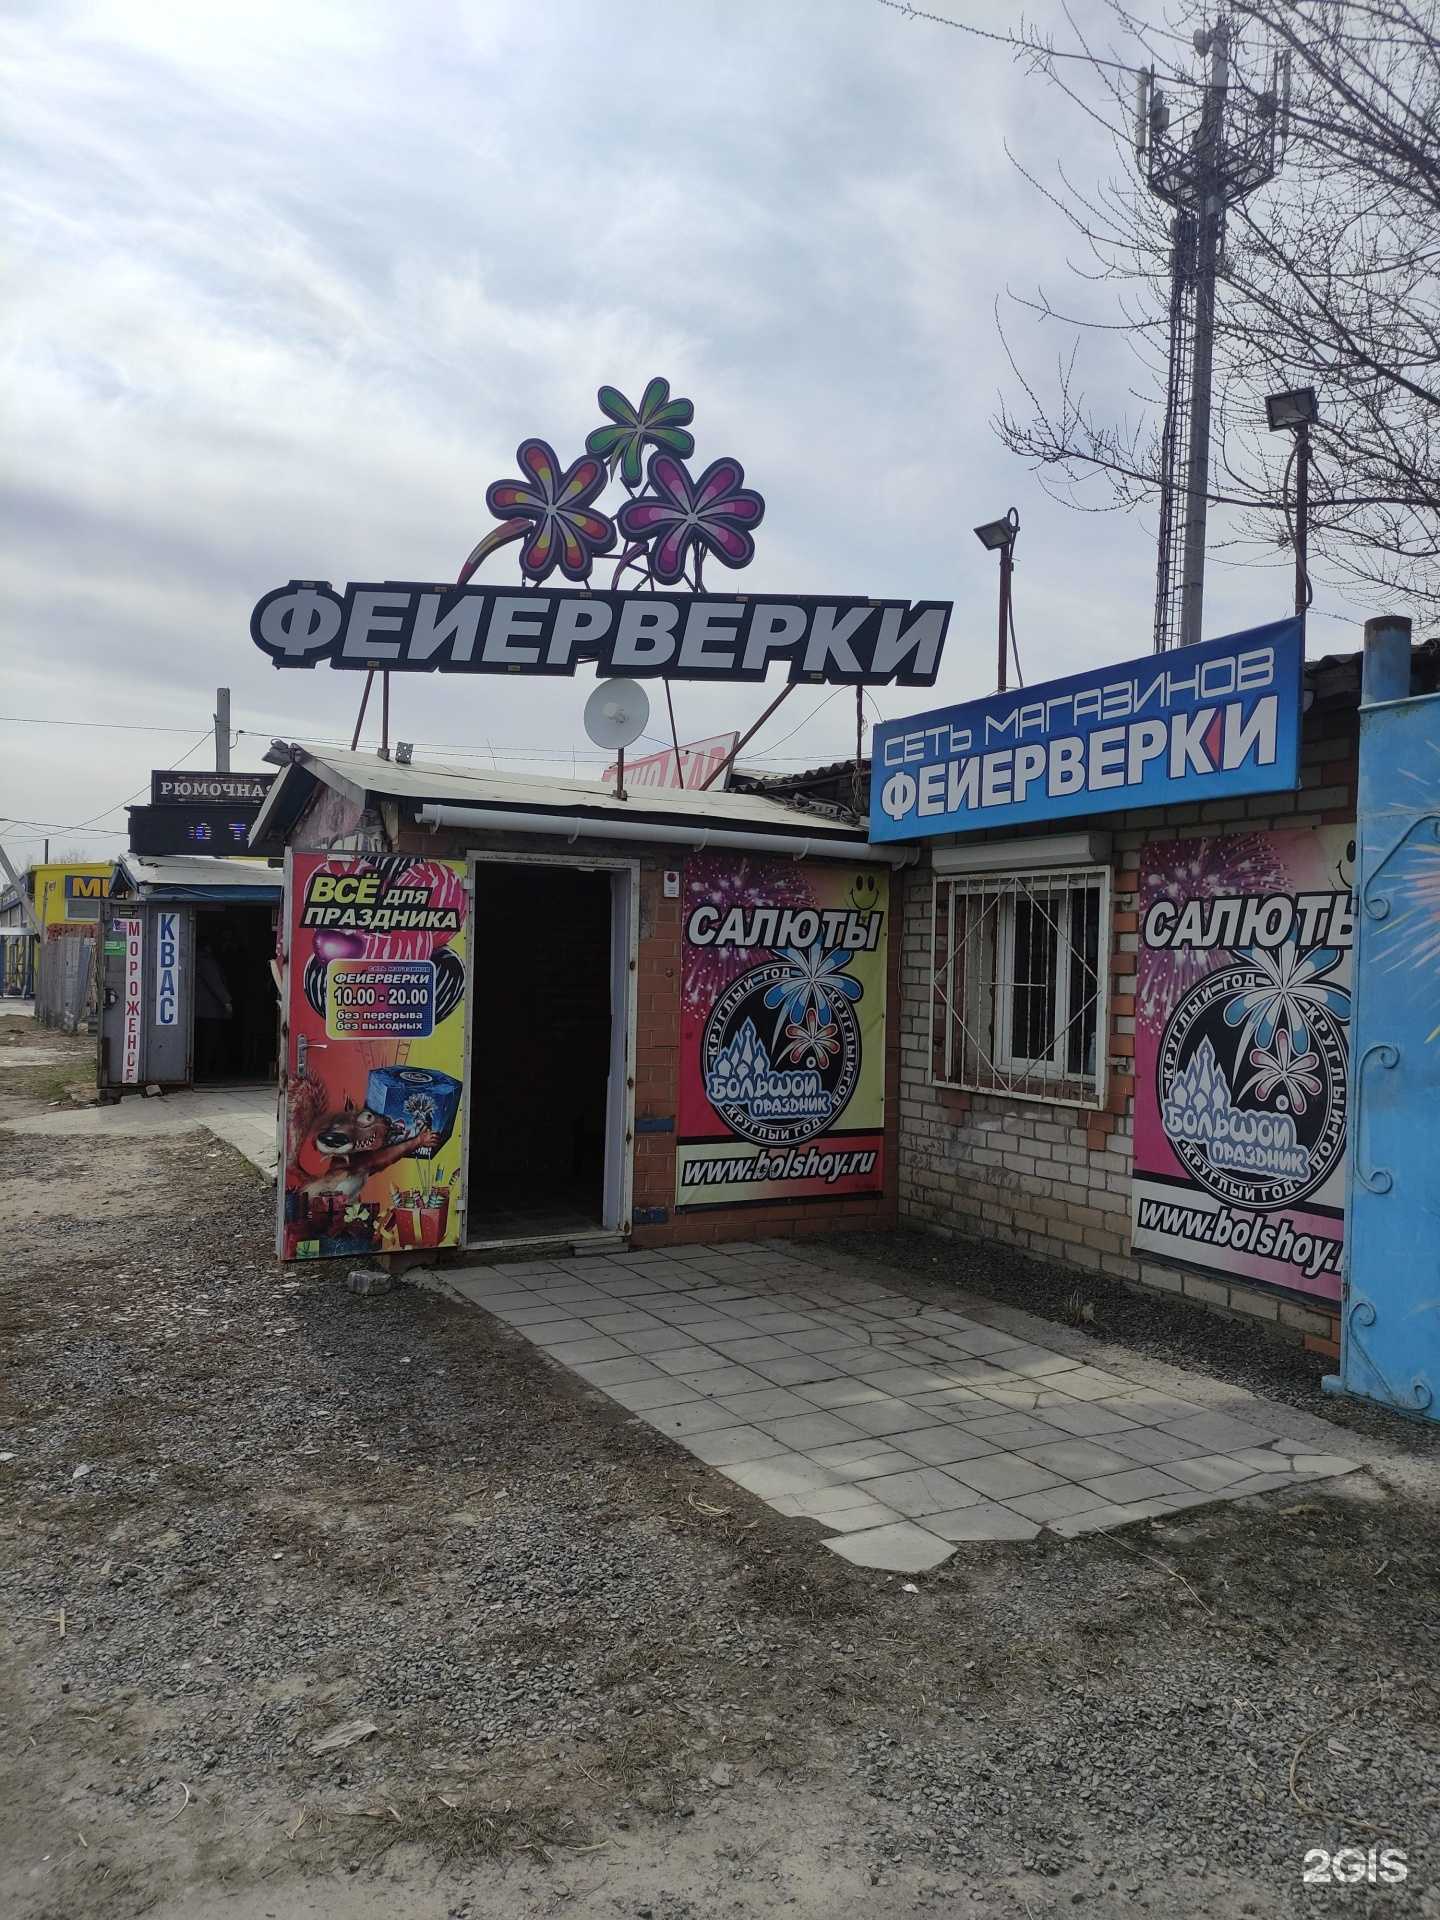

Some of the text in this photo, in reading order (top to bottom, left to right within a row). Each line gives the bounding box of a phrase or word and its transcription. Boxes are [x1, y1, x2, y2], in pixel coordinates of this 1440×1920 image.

[884, 647, 1275, 767] СЕТЬ МАГАЗИНОВ
[309, 873, 381, 904] ВСЁ
[303, 907, 458, 930] ПРАЗДНИКА
[688, 906, 881, 949] САЛЮТЫ
[159, 914, 176, 1025] КВАС
[763, 967, 791, 981] ГОД
[1222, 973, 1257, 991] ГОД
[334, 988, 375, 1005] 10.00
[388, 988, 428, 1005] 20.00
[336, 1022, 423, 1031] без выходных
[337, 1011, 423, 1021] без перерыва
[832, 1075, 852, 1106] ГОД
[753, 1097, 829, 1115] ПРАЗДНИК
[794, 1118, 822, 1137] ГОД
[1212, 1140, 1306, 1174] ПРАЗДНИК
[1310, 1128, 1339, 1175] ГОД
[684, 1149, 876, 1184] www.bolshoy.ru
[1261, 1181, 1297, 1201] ГОД
